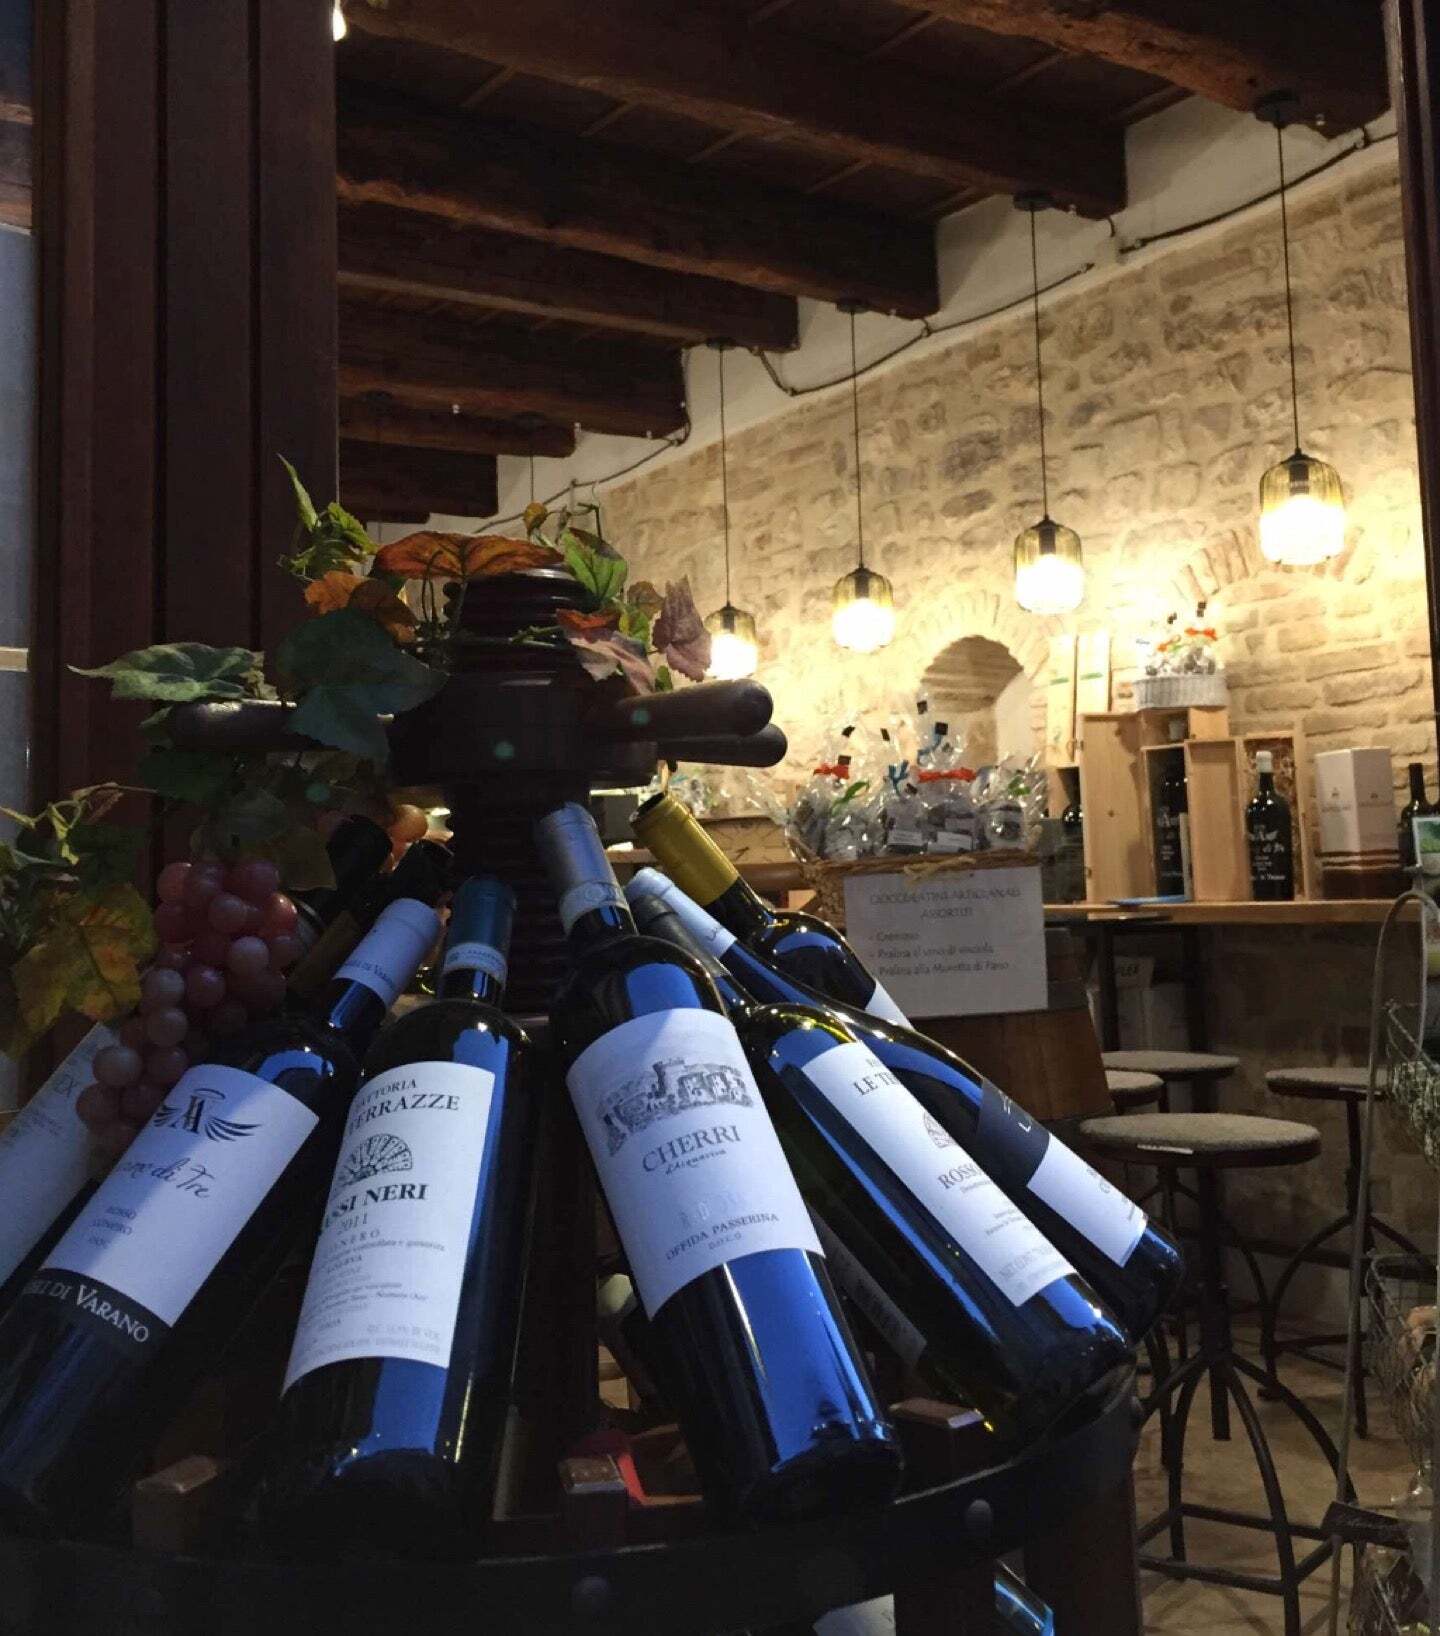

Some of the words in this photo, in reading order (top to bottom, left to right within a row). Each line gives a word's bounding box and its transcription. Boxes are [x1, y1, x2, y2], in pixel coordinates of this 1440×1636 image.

[853, 1076, 878, 1096] LE
[642, 1125, 741, 1173] CHERRI
[363, 1183, 429, 1207] NERI
[76, 1284, 150, 1343] VARANO
